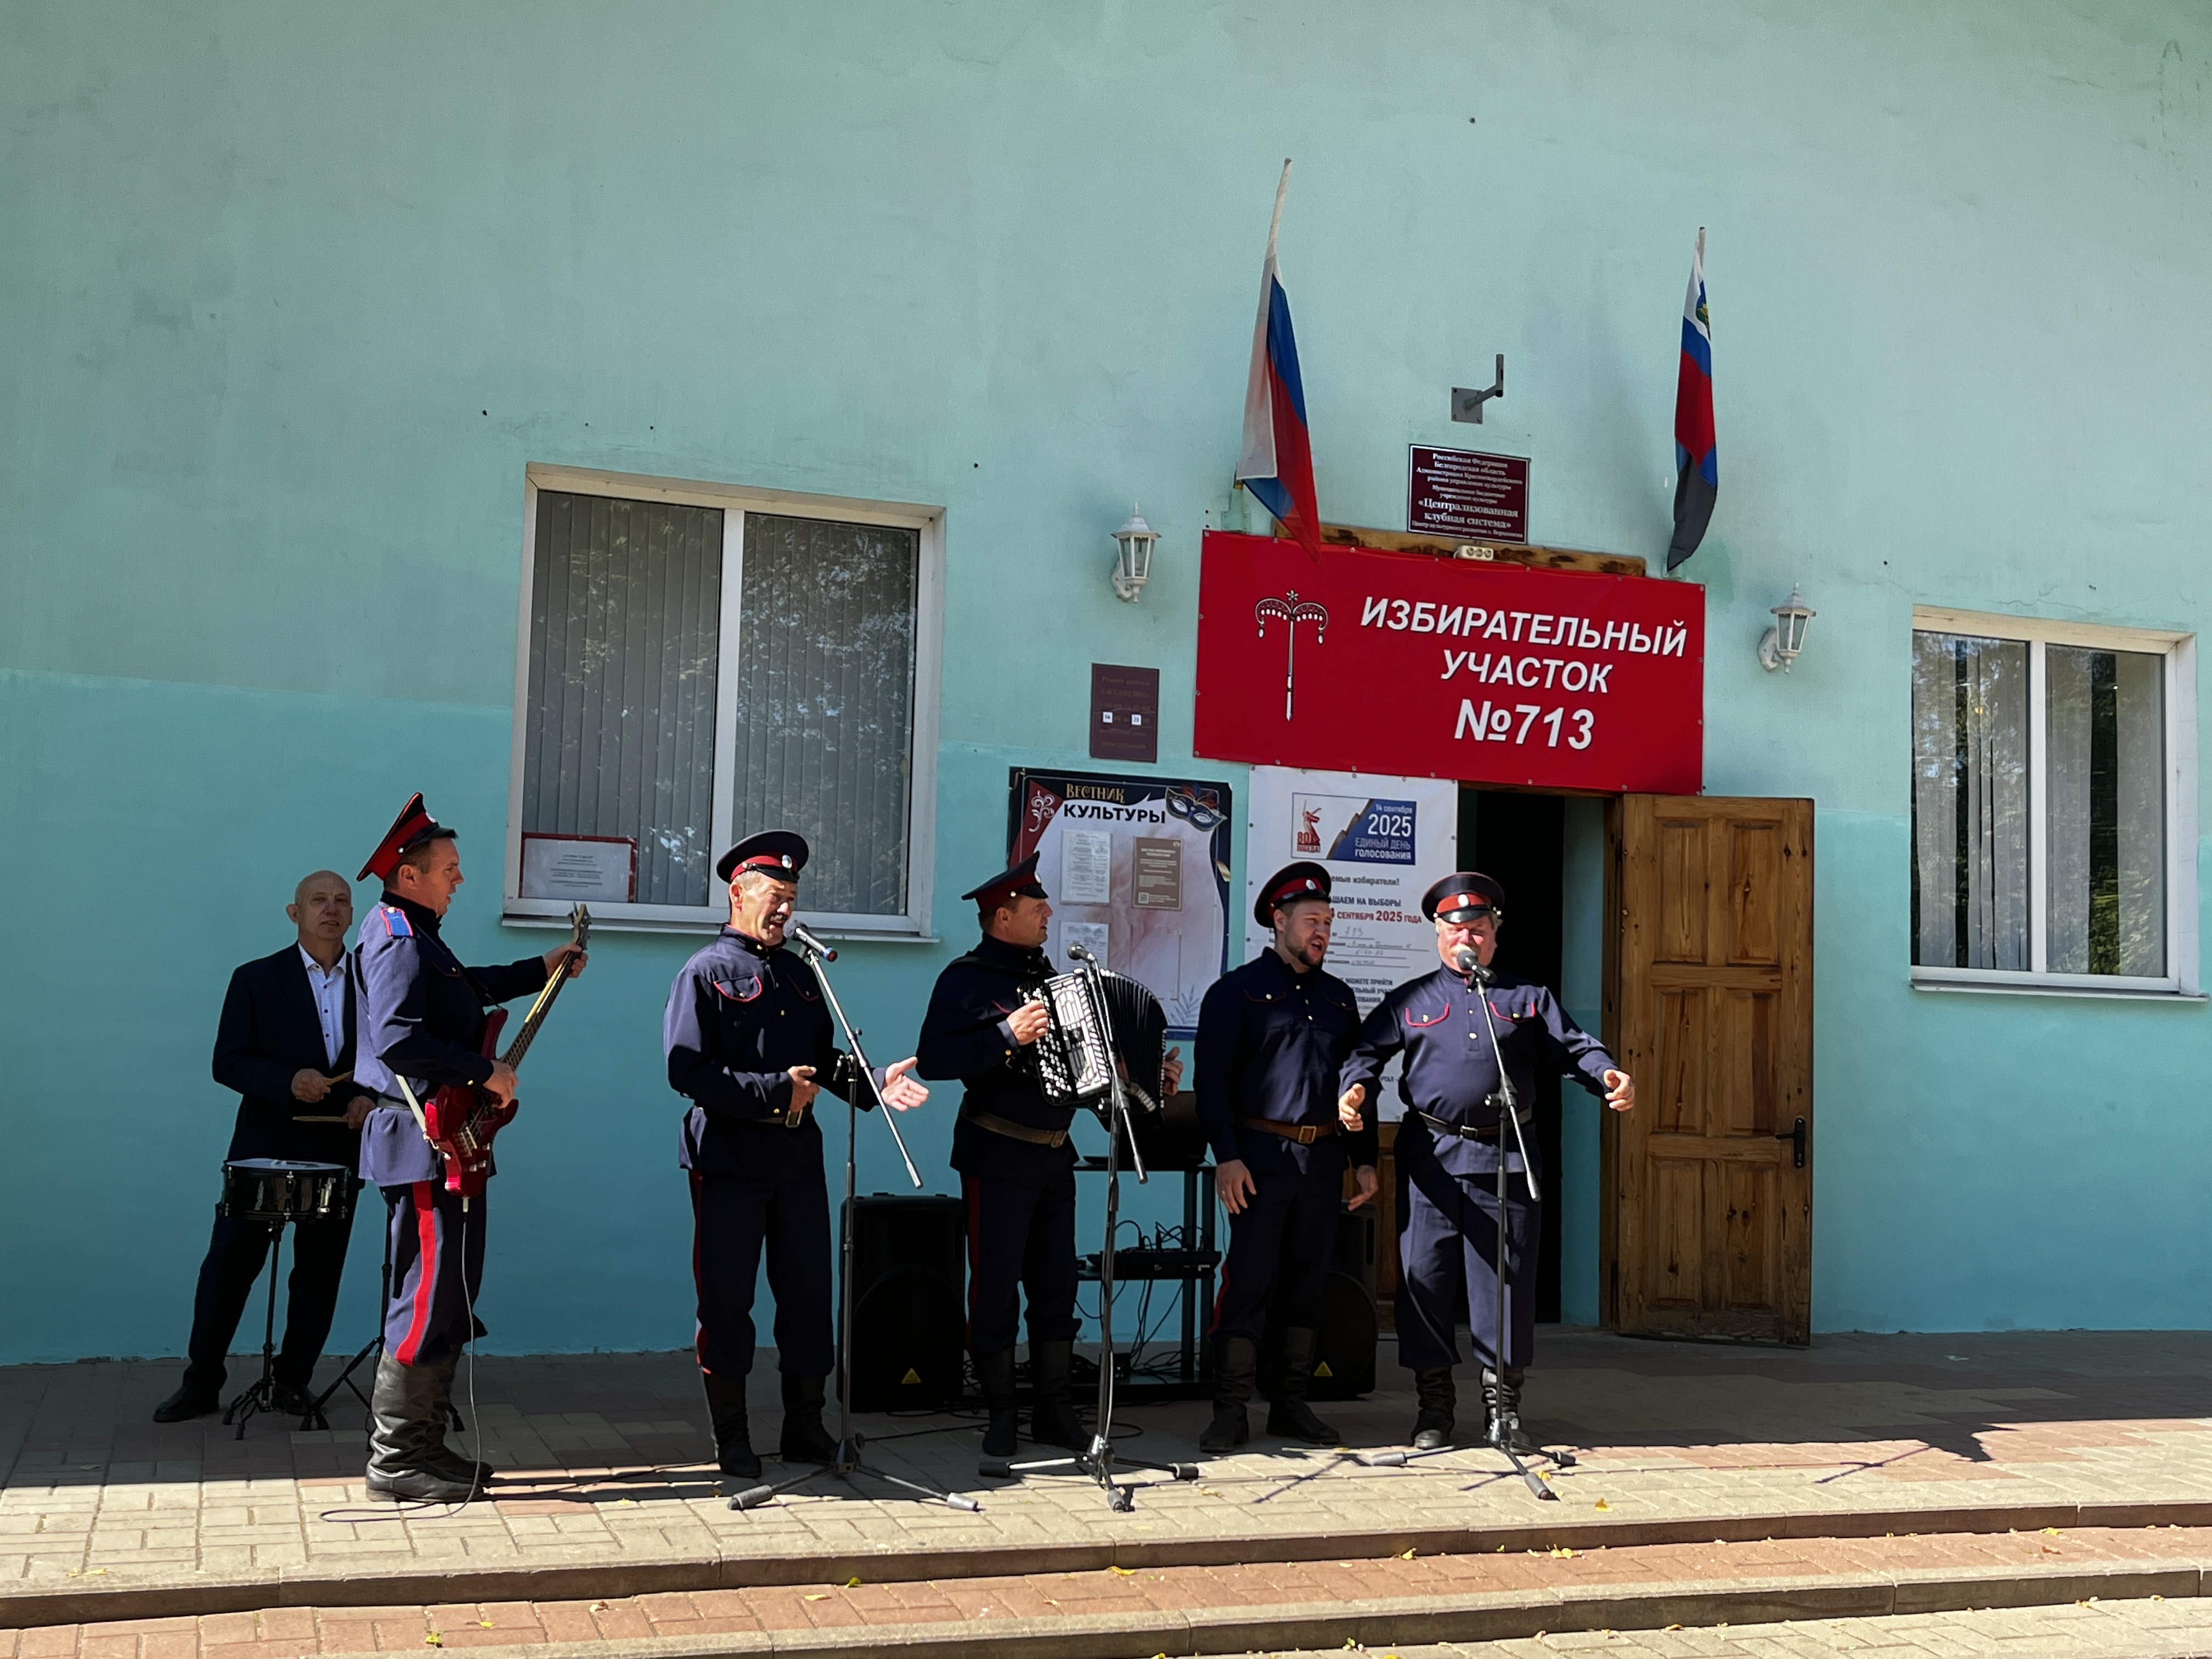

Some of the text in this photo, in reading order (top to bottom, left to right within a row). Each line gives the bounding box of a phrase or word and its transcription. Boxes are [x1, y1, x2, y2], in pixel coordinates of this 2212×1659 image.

[1418, 498, 1518, 517] «Централизованная
[1424, 512, 1511, 528] клубная система»
[1361, 596, 1687, 657] ИЗБИРАТЕЛЬНЫЙ
[1441, 649, 1613, 693] УЧАСТОК
[1454, 698, 1594, 750] №713
[1066, 783, 1125, 804] ВЕСТНИК
[1064, 804, 1166, 823] КУЛЬТУРЫ
[1384, 805, 1413, 814] сентября
[1367, 814, 1412, 837] 2025
[1355, 837, 1411, 850] ЕДИНЫЙ ДЕНЬ
[1355, 849, 1412, 860] голосования
[1353, 876, 1400, 886] избиратели!
[1357, 897, 1367, 905] НА
[1368, 898, 1401, 907] ВЫБОРЫ
[1337, 911, 1374, 921] СЕНТЯБРЯ
[1376, 910, 1403, 922] 2025
[1404, 915, 1422, 924] ГОДА
